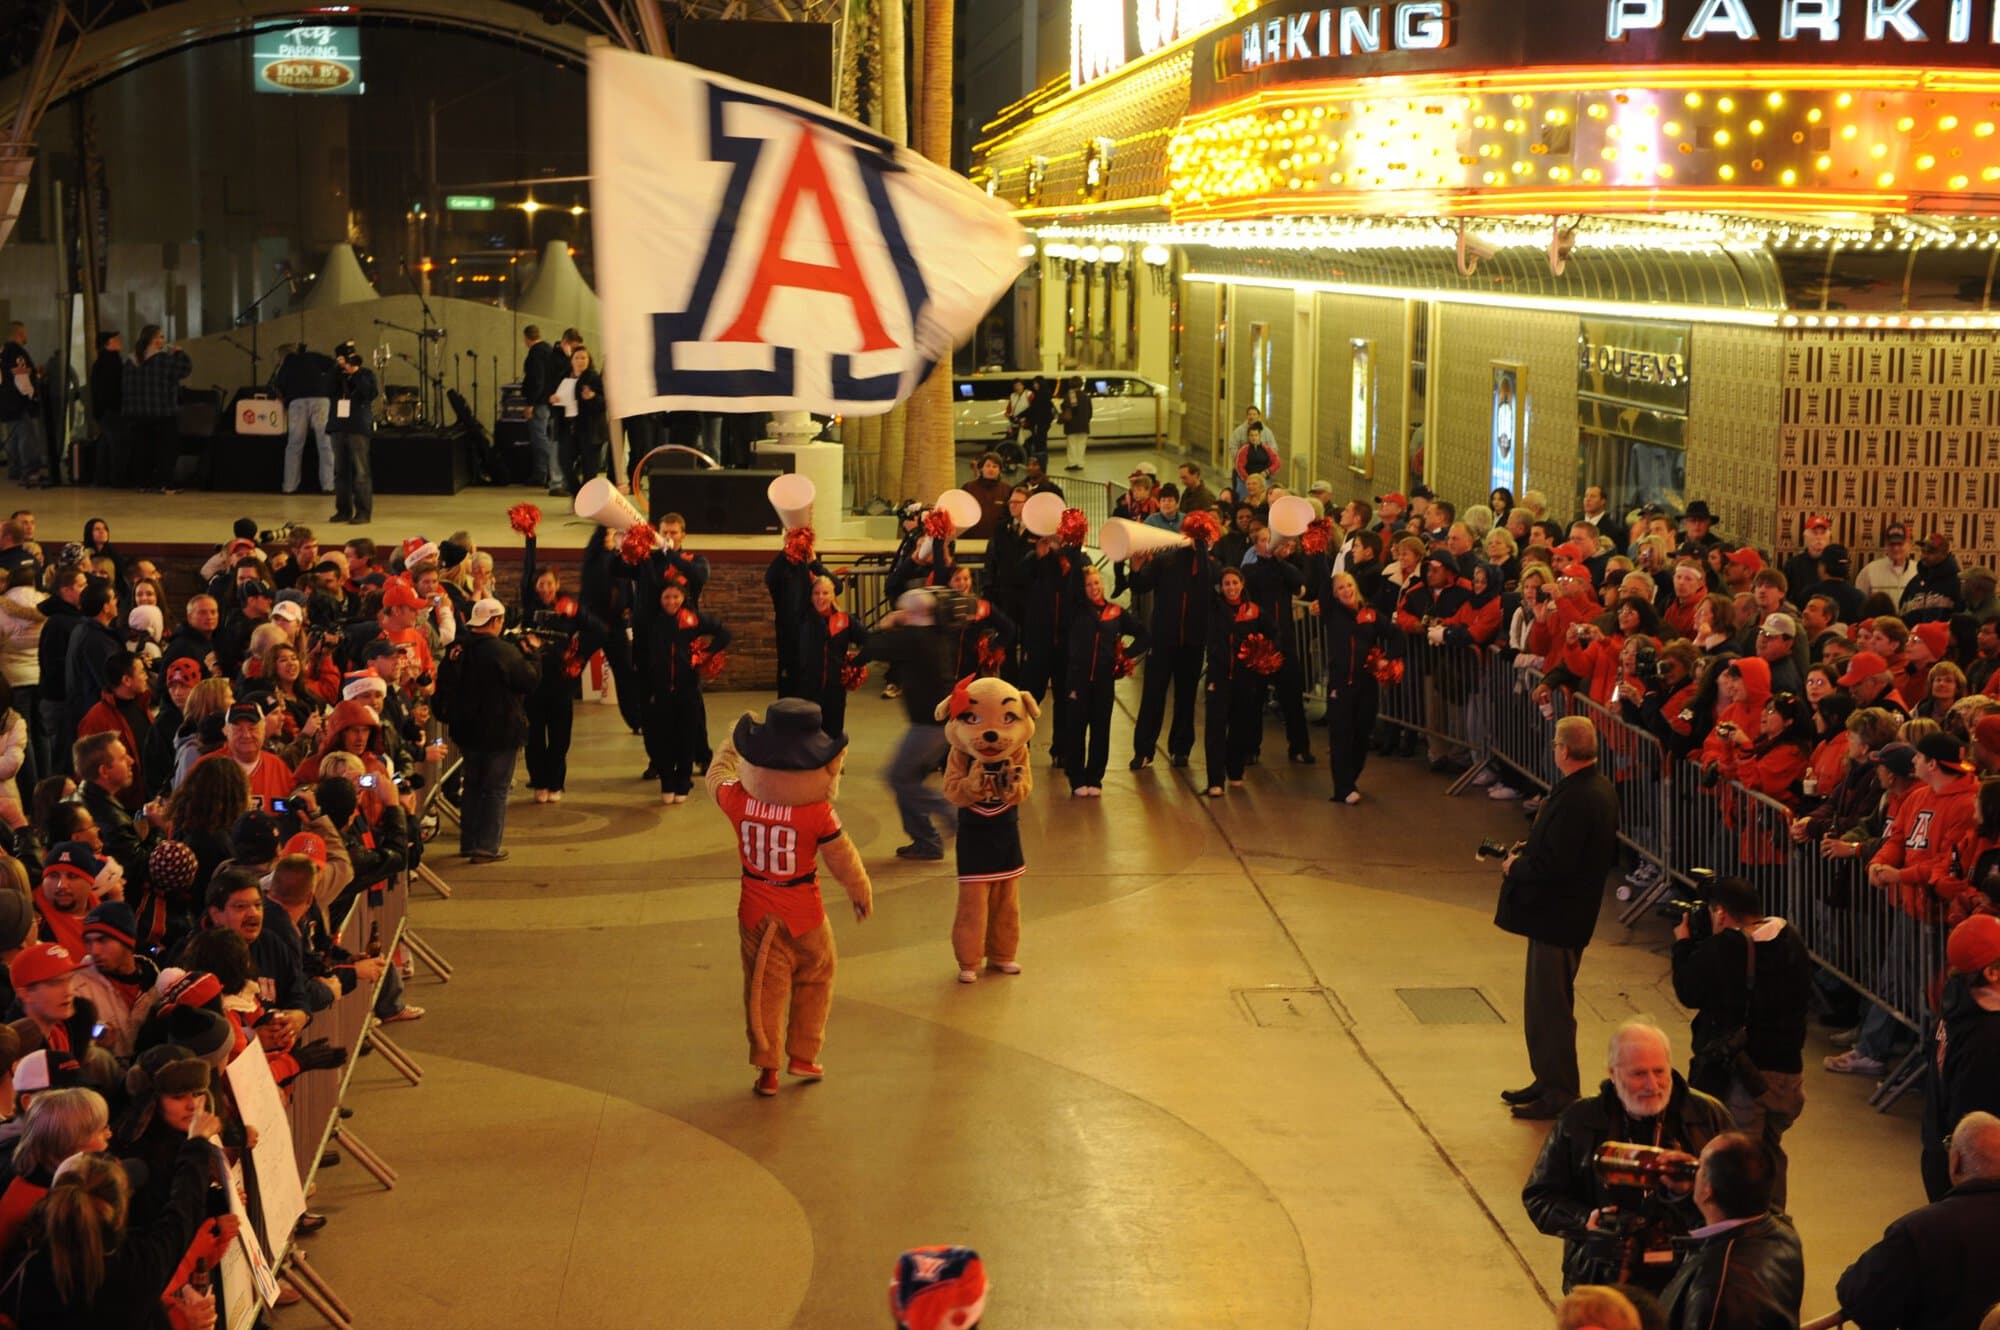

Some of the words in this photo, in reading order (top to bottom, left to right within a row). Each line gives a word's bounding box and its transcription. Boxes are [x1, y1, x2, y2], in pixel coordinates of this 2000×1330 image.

[1242, 3, 1450, 71] PARKING
[1596, 0, 2000, 42] PARKI
[276, 64, 314, 77] DON
[279, 44, 338, 57] PARKING
[653, 80, 935, 400] A
[1599, 345, 1683, 386] QUEENS
[741, 820, 797, 876] 08
[1905, 811, 1935, 849] A
